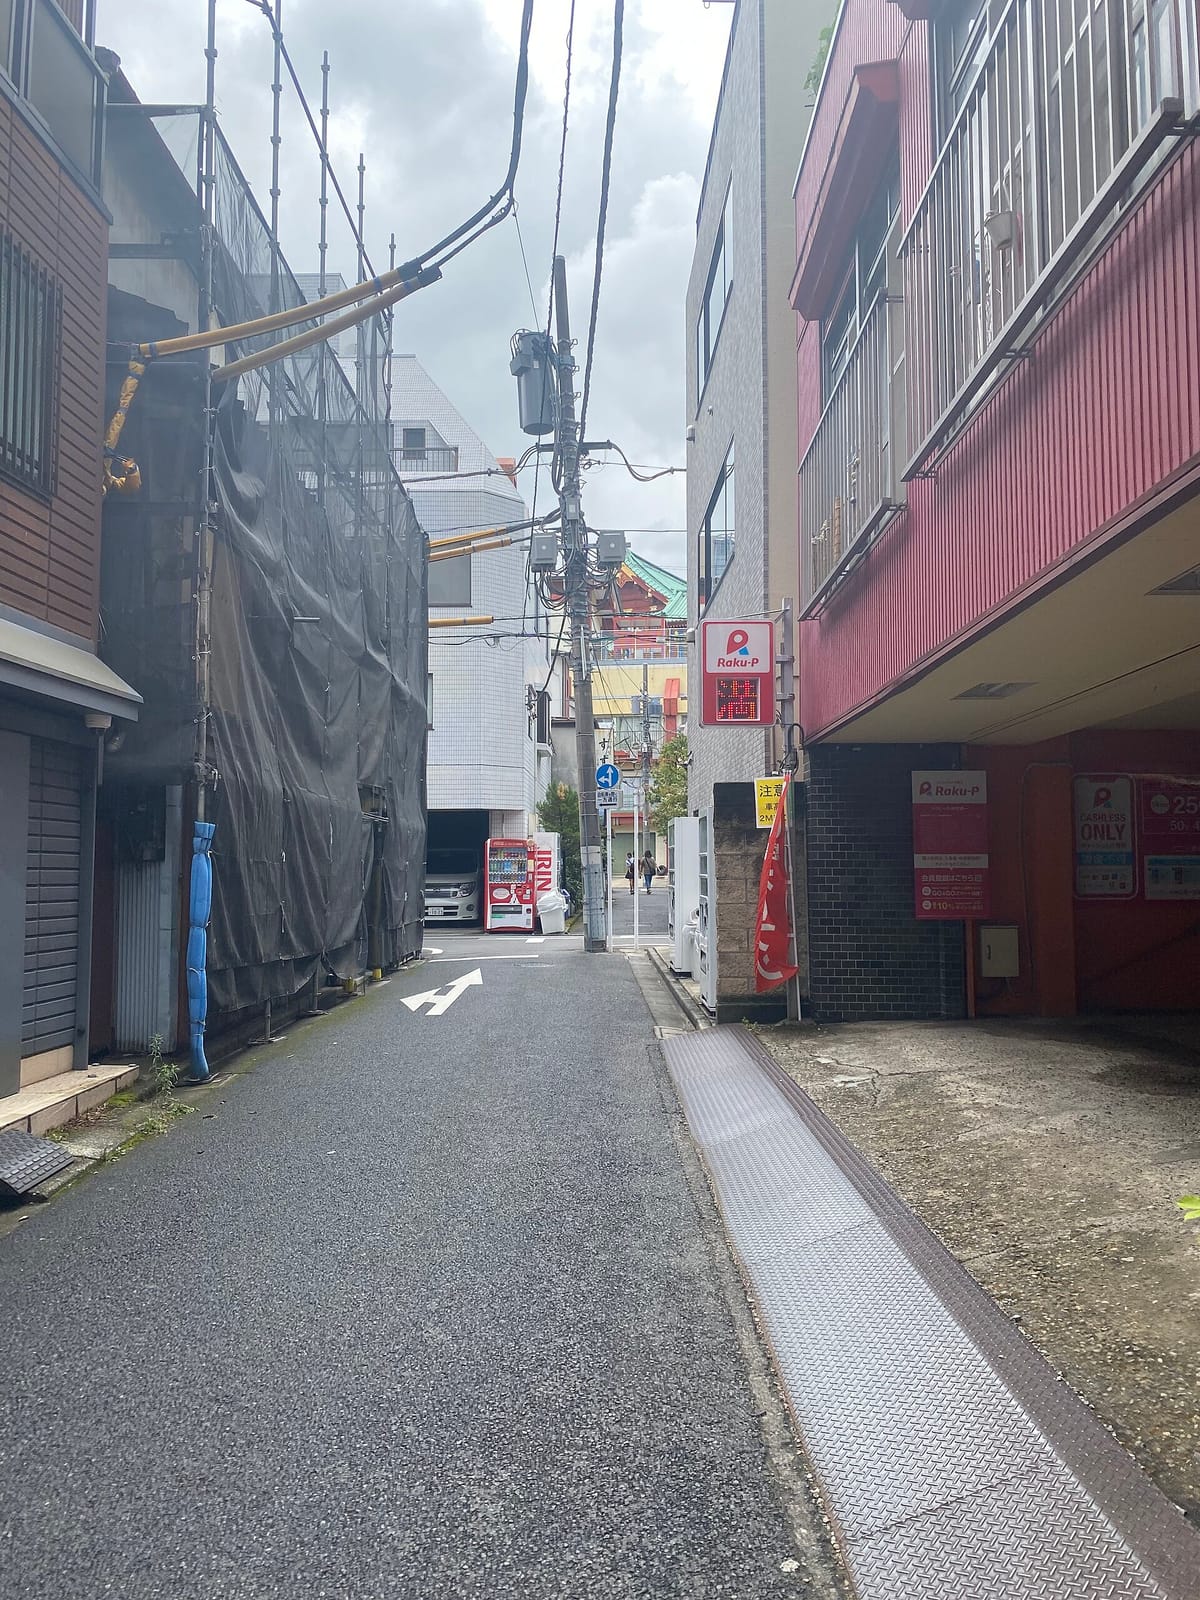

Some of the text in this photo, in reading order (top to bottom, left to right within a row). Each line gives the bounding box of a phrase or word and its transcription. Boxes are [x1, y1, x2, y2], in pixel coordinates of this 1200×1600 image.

[717, 680, 758, 719] 満
[759, 783, 783, 797] 注意
[1174, 796, 1200, 814] 25
[1080, 813, 1126, 822] CASHLESS
[1081, 823, 1126, 841] ONLY
